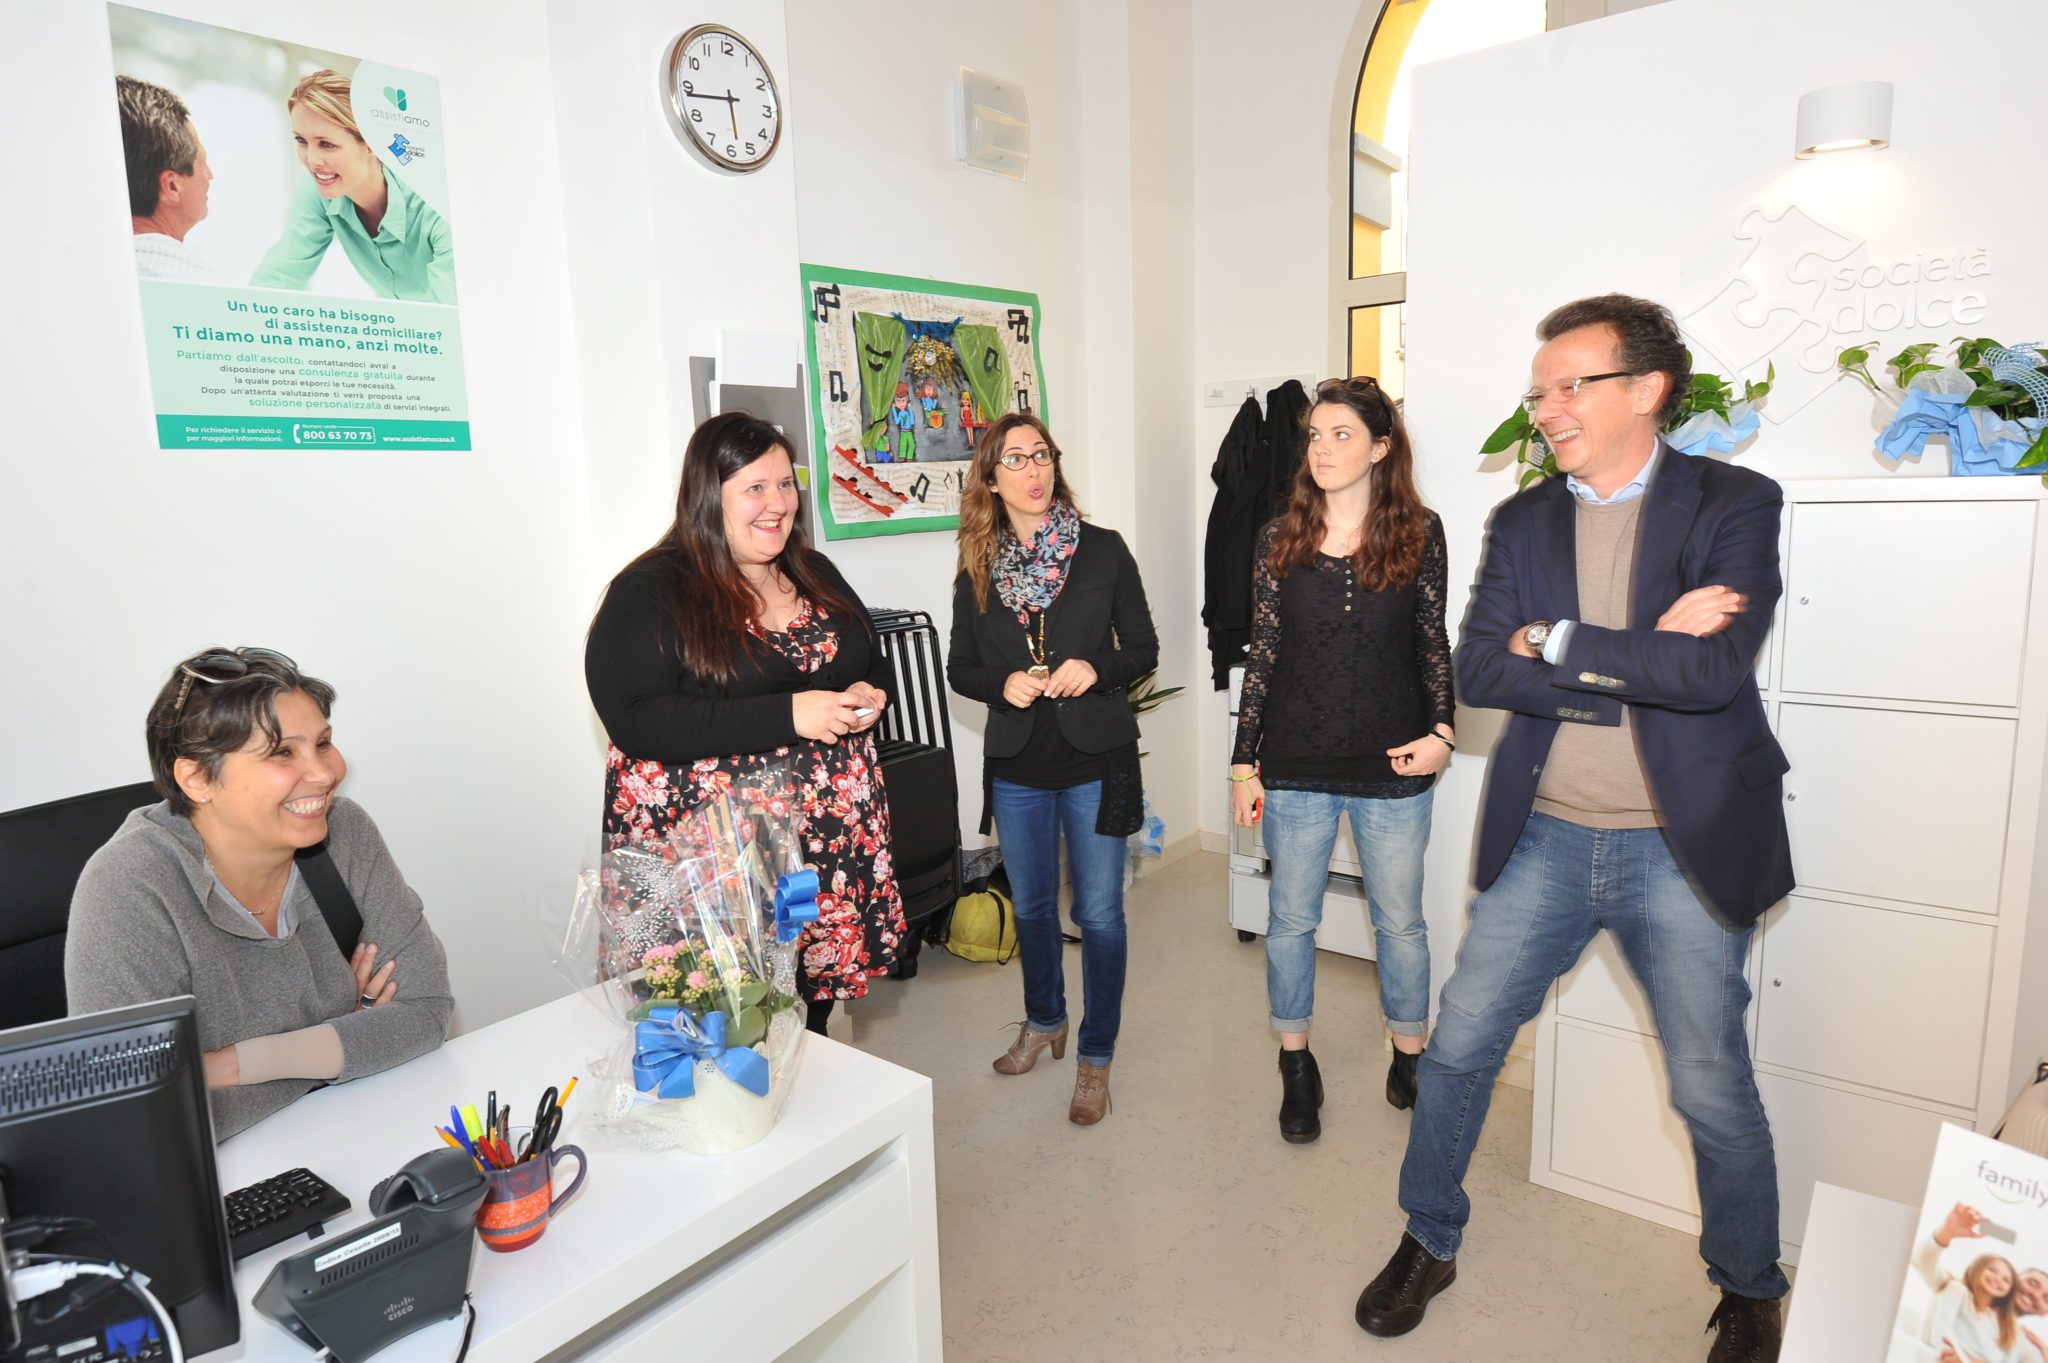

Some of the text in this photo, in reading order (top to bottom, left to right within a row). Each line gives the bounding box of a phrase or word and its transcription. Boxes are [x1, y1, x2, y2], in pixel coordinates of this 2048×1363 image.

[703, 43, 711, 57] 11
[720, 41, 734, 56] 12
[688, 56, 700, 71] 10
[745, 55, 749, 67] 1
[682, 80, 694, 95] 9
[755, 78, 766, 91] 2
[371, 109, 430, 127] assistiamo
[691, 109, 703, 122] 8
[762, 105, 772, 118] 3
[706, 132, 716, 146] 7
[758, 128, 768, 140] 4
[726, 144, 737, 158] 6
[745, 142, 756, 155] 5
[1832, 247, 1992, 292] società
[227, 300, 395, 324] Un tuo caro ha bisogno
[1831, 287, 1987, 334] dolce
[265, 318, 442, 341] di assistenza domiciliare?
[172, 325, 443, 355] Ti diamo una mano, anzi molte.
[177, 350, 232, 361] Partiamo
[236, 353, 305, 365] dall'ascolto:
[308, 359, 366, 368] contattandoci
[220, 365, 276, 375] disposizione
[299, 368, 359, 378] consulenza
[363, 371, 403, 380] gratuita
[245, 377, 270, 386] quale
[272, 379, 298, 387] potrai
[300, 380, 330, 388] esporci
[201, 386, 226, 395] Dopo
[231, 388, 277, 396] un'attenta
[281, 389, 330, 398] valutazione
[368, 393, 403, 401] proposta
[249, 398, 303, 408] soluzione
[306, 400, 382, 410] personalizzata
[187, 435, 200, 443] per
[201, 435, 234, 443] maggiori
[303, 431, 372, 440] 800 63 70 73
[1977, 1160, 2048, 1209] family
